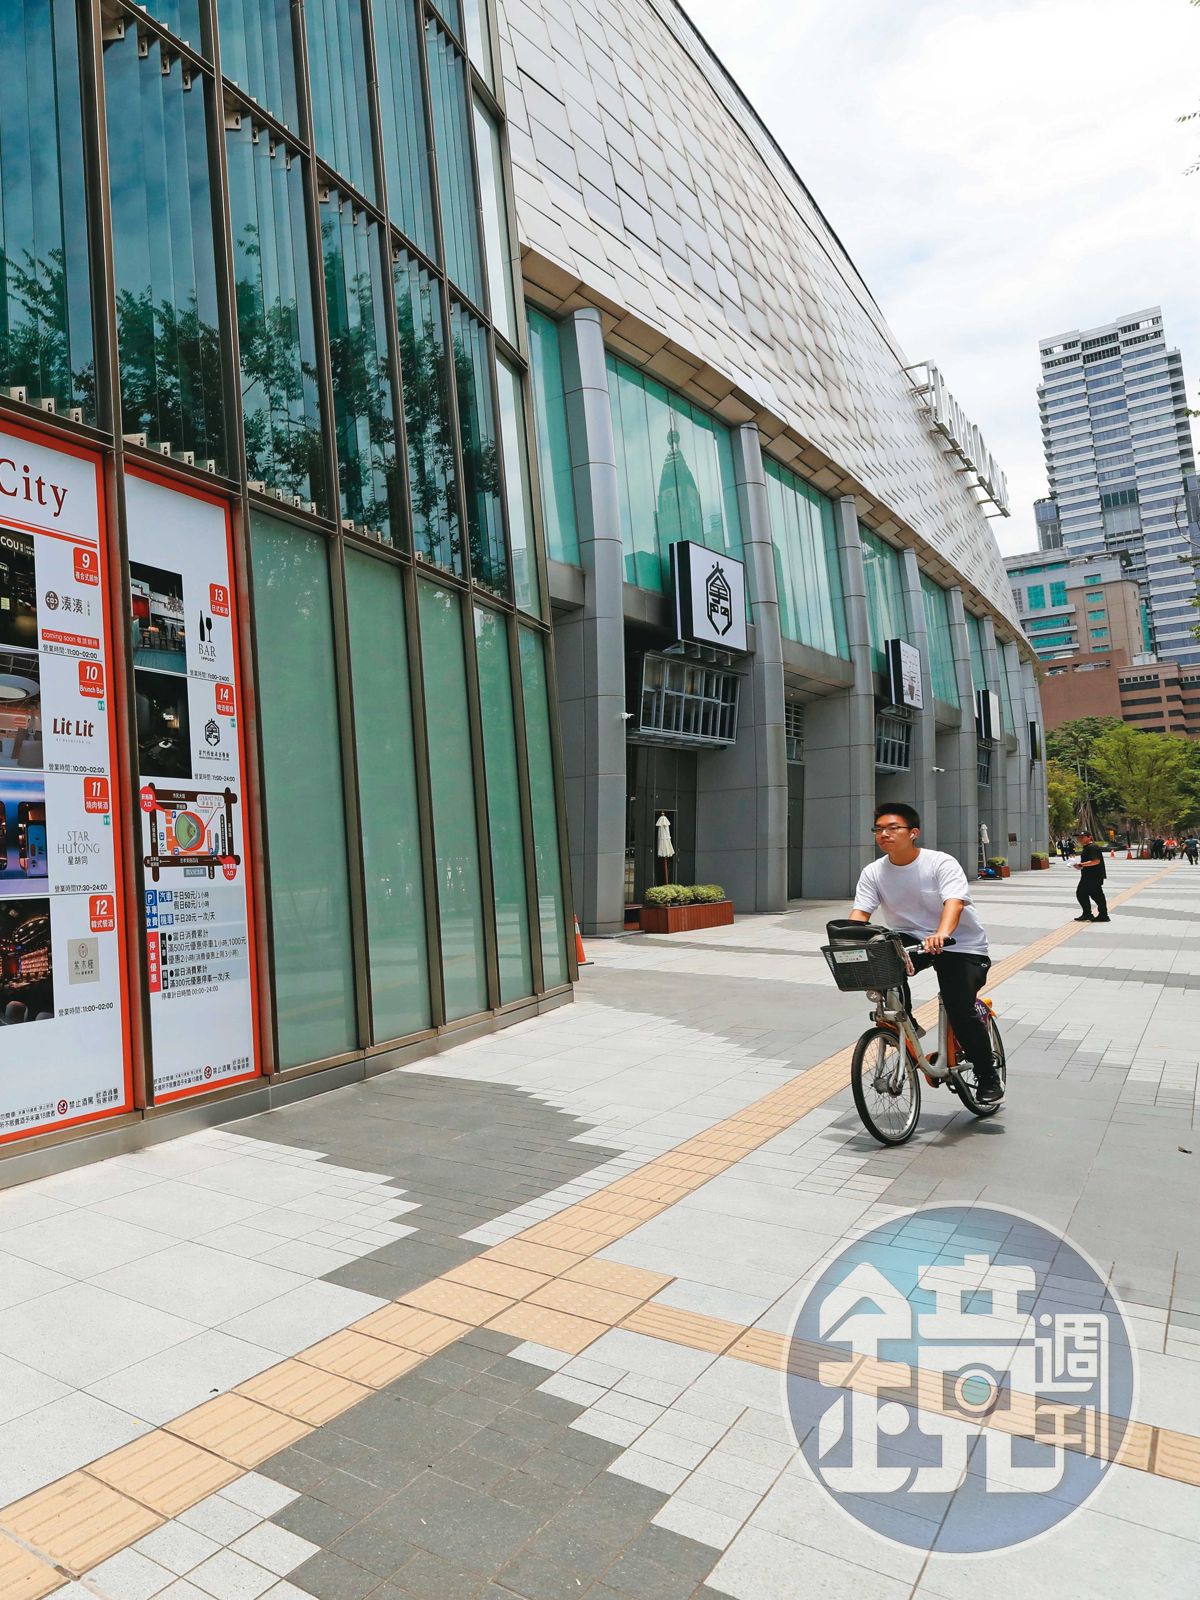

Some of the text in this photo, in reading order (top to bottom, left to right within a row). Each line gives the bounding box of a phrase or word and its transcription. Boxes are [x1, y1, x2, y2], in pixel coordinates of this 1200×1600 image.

[82, 553, 90, 568] 9
[215, 589, 223, 602] 13
[62, 596, 83, 614] 湊湊
[43, 632, 62, 641] coming
[199, 644, 216, 657] BAR
[86, 666, 97, 680] 10
[220, 688, 229, 701] 14
[53, 718, 94, 737] Lit Lit
[92, 782, 101, 796] 11
[67, 831, 89, 843] STAR
[58, 843, 99, 854] HUTONG
[96, 900, 107, 915] 12
